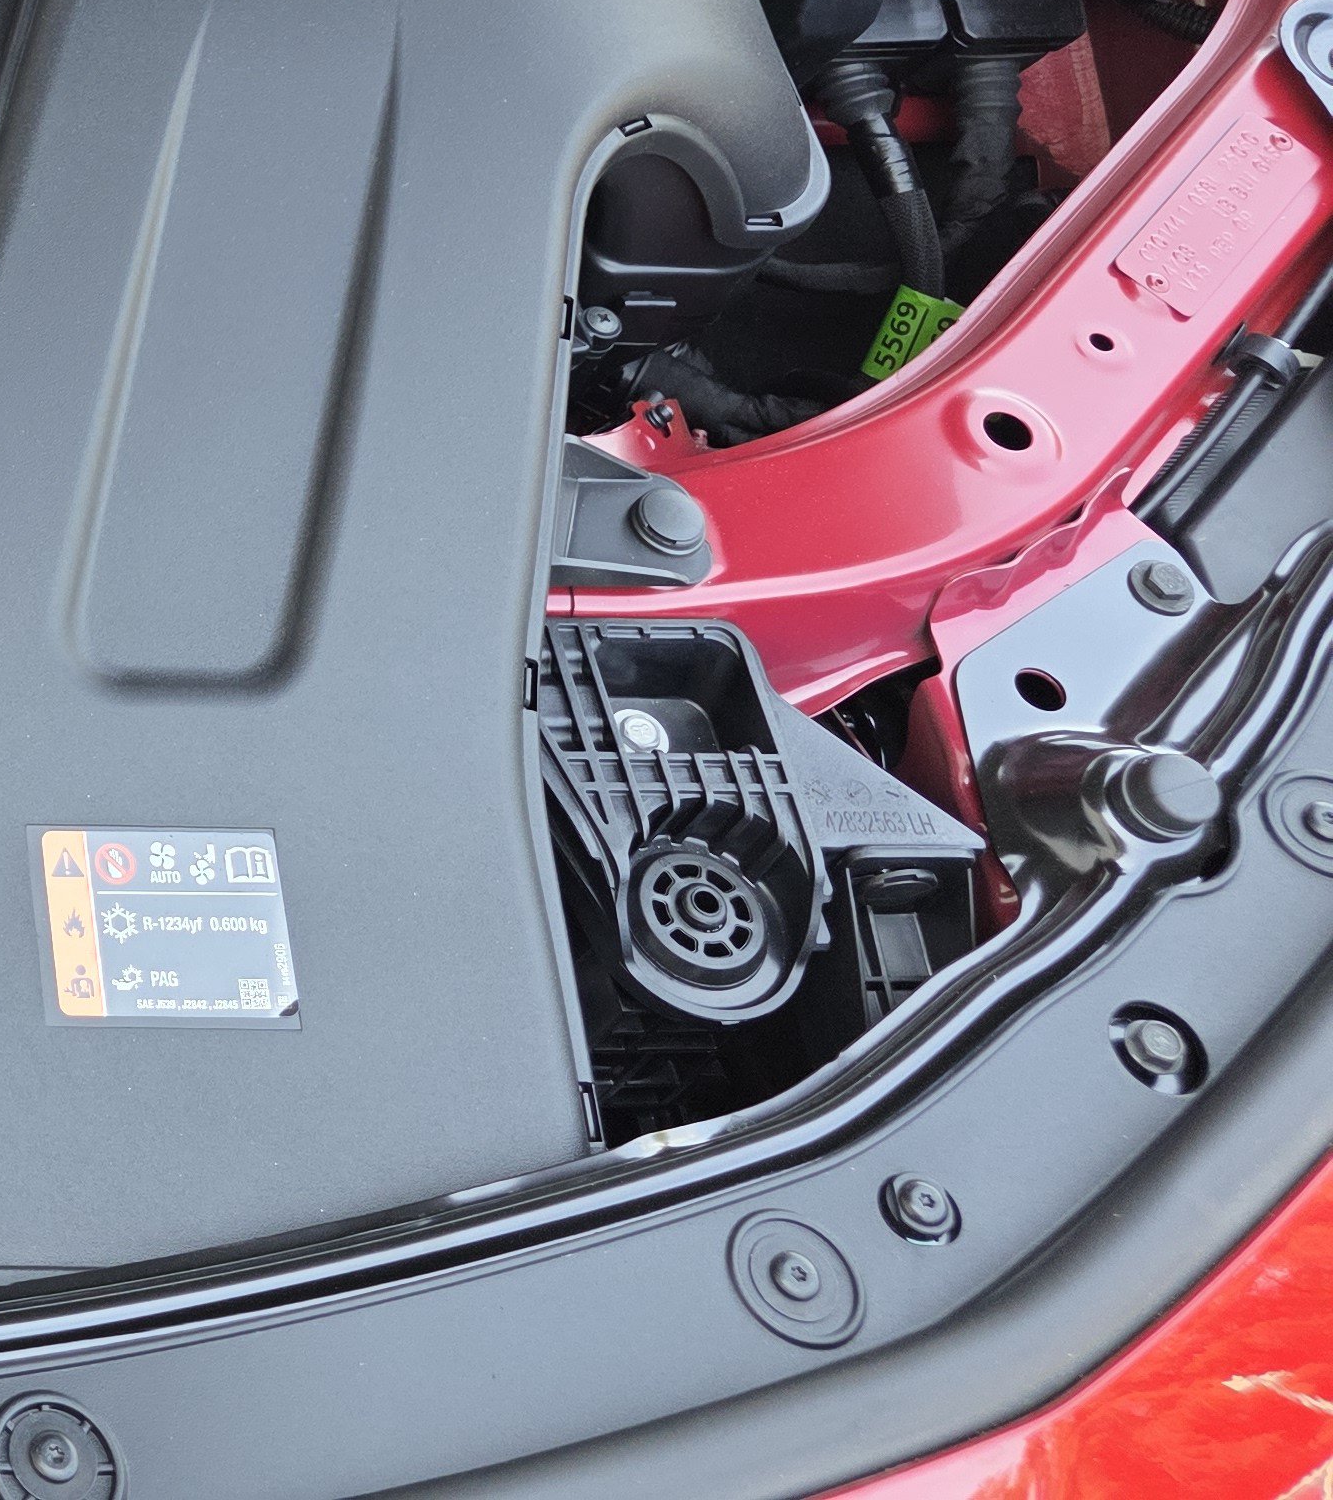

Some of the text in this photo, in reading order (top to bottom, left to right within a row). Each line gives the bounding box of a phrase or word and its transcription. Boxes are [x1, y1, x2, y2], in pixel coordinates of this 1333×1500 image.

[873, 301, 919, 371] 5569
[150, 871, 181, 883] AUTO
[142, 916, 268, 934] R-1234yf 0.600 kg
[151, 971, 178, 987] PAG
[136, 999, 154, 1009] SAE
